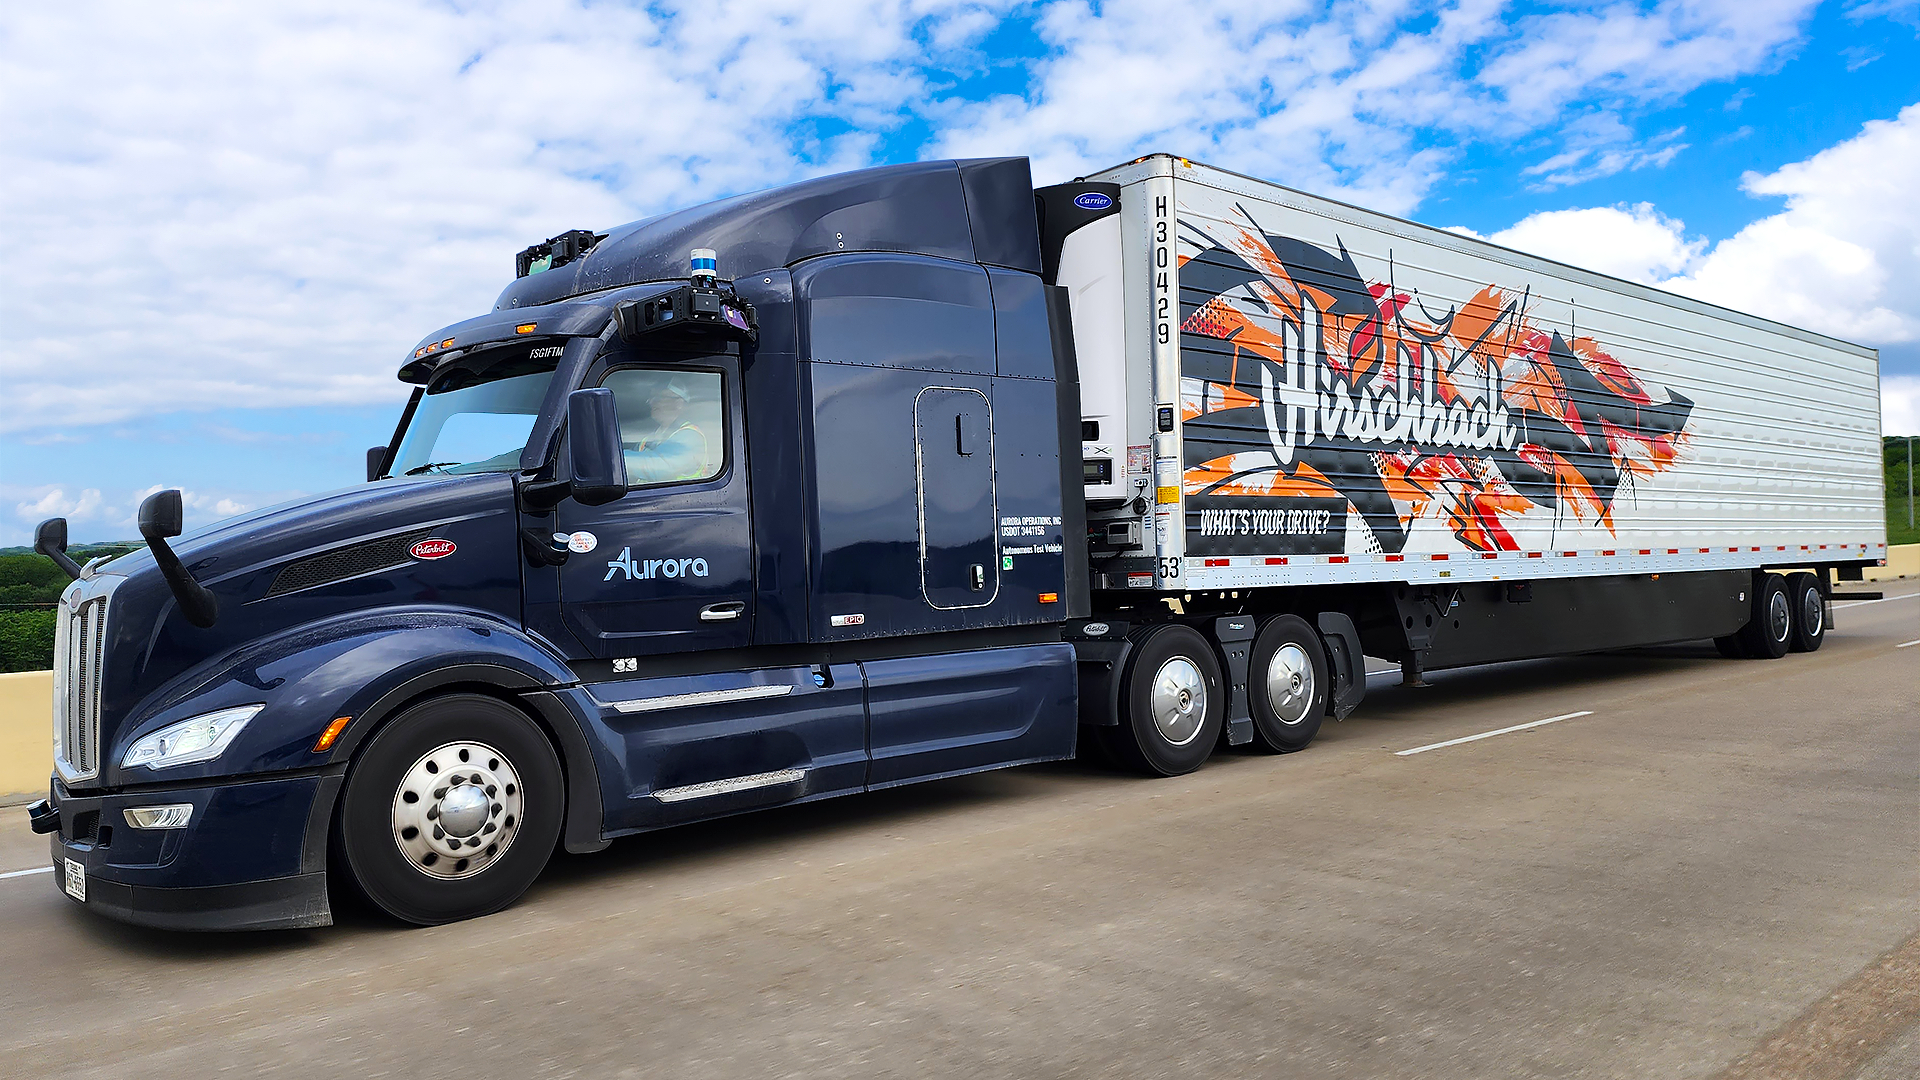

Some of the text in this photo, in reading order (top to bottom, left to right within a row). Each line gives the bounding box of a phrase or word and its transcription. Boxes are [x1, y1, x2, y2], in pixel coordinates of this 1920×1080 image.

[1155, 196, 1169, 344] H30429
[1001, 516, 1021, 526] AURORA
[1200, 509, 1331, 535] WHAT'S YOUR DRIVE?
[1001, 526, 1020, 537] USDOT
[415, 543, 451, 555] Peterbilt
[1033, 545, 1044, 553] Test
[603, 547, 709, 581] Aurora
[1159, 557, 1182, 578] 53'
